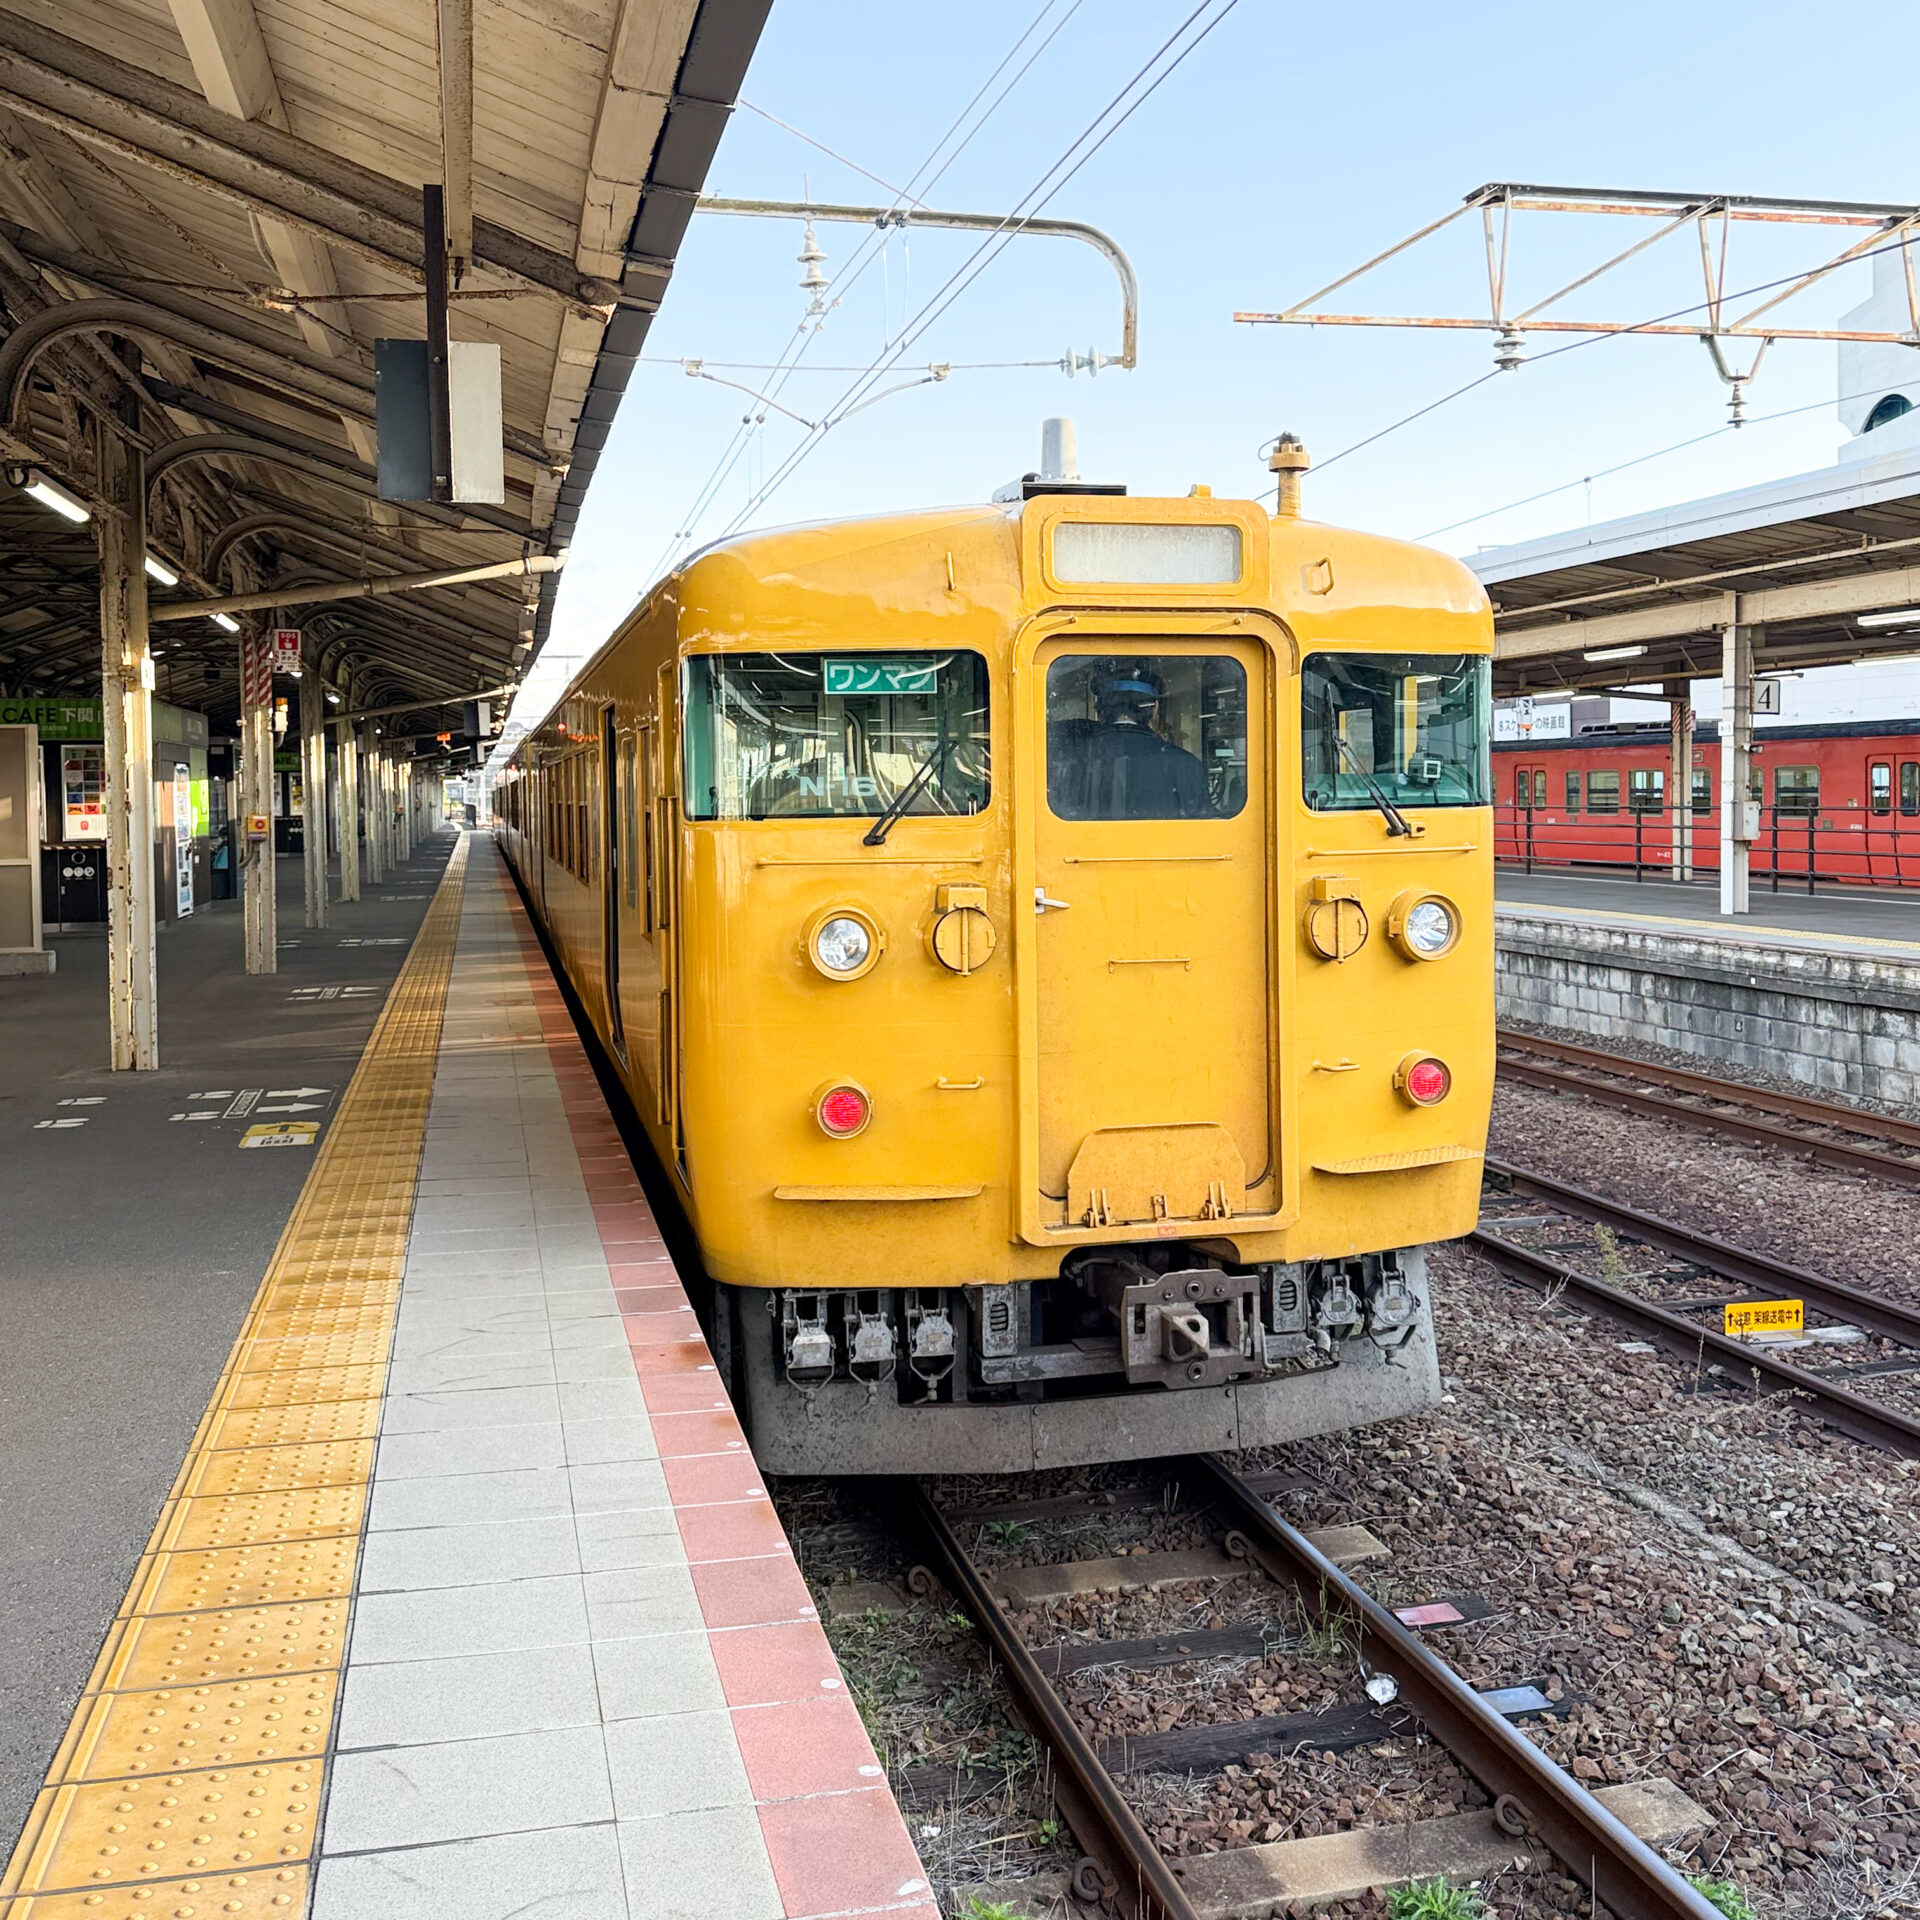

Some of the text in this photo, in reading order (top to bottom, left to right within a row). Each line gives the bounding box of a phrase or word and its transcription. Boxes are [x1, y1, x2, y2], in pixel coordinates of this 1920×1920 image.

[829, 664, 932, 690] ワンマン
[1757, 684, 1772, 710] 4
[2, 706, 94, 723] CAFE 下関
[799, 776, 877, 797] N-16
